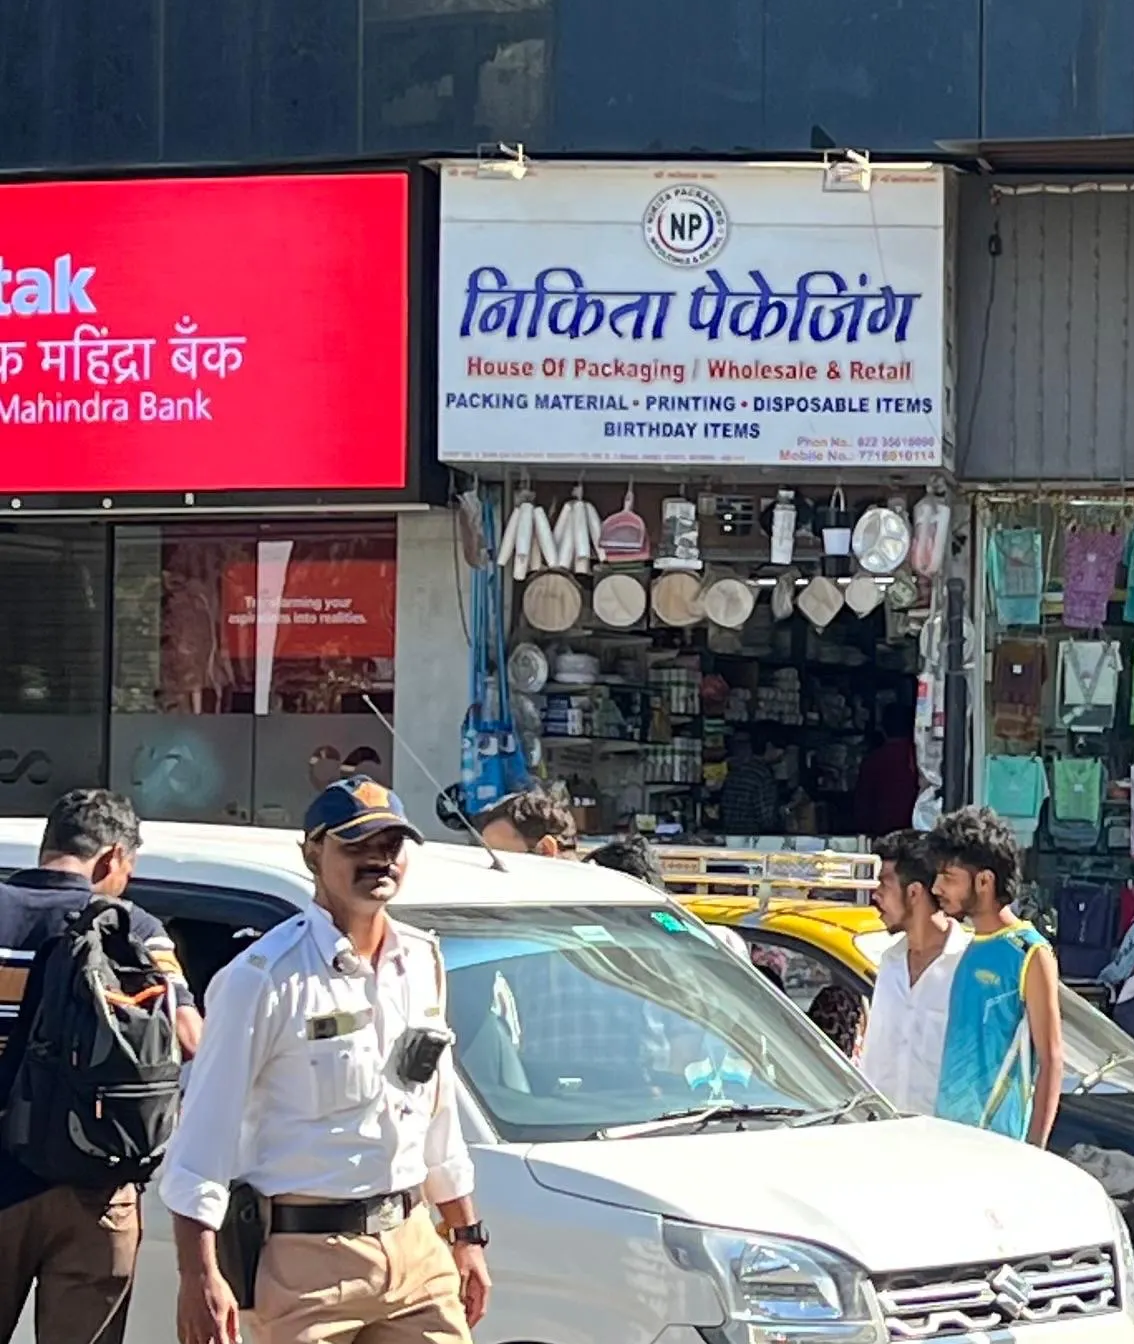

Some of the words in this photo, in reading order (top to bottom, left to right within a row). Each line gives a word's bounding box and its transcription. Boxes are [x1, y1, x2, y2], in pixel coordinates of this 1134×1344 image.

[670, 213, 702, 241] NP
[459, 266, 676, 340] निकिता
[687, 267, 922, 342] पेकेजिंग
[37, 323, 157, 384] महिंद्रा
[467, 359, 534, 377] House
[542, 359, 565, 377] Of
[574, 359, 685, 383] Packaging
[707, 360, 818, 380] Wholesale
[826, 362, 841, 380] &
[850, 361, 912, 380] Retail
[0, 390, 129, 424] Mahindra
[140, 388, 212, 422] Bank
[445, 392, 529, 409] PACKING
[534, 394, 629, 411] MATERIAL
[645, 395, 736, 412] PRINTING
[753, 396, 869, 413] DISPOSABLE
[876, 398, 933, 414] ITEMS
[604, 422, 697, 438] BIRTHDAY
[704, 423, 760, 438] ITEMS
